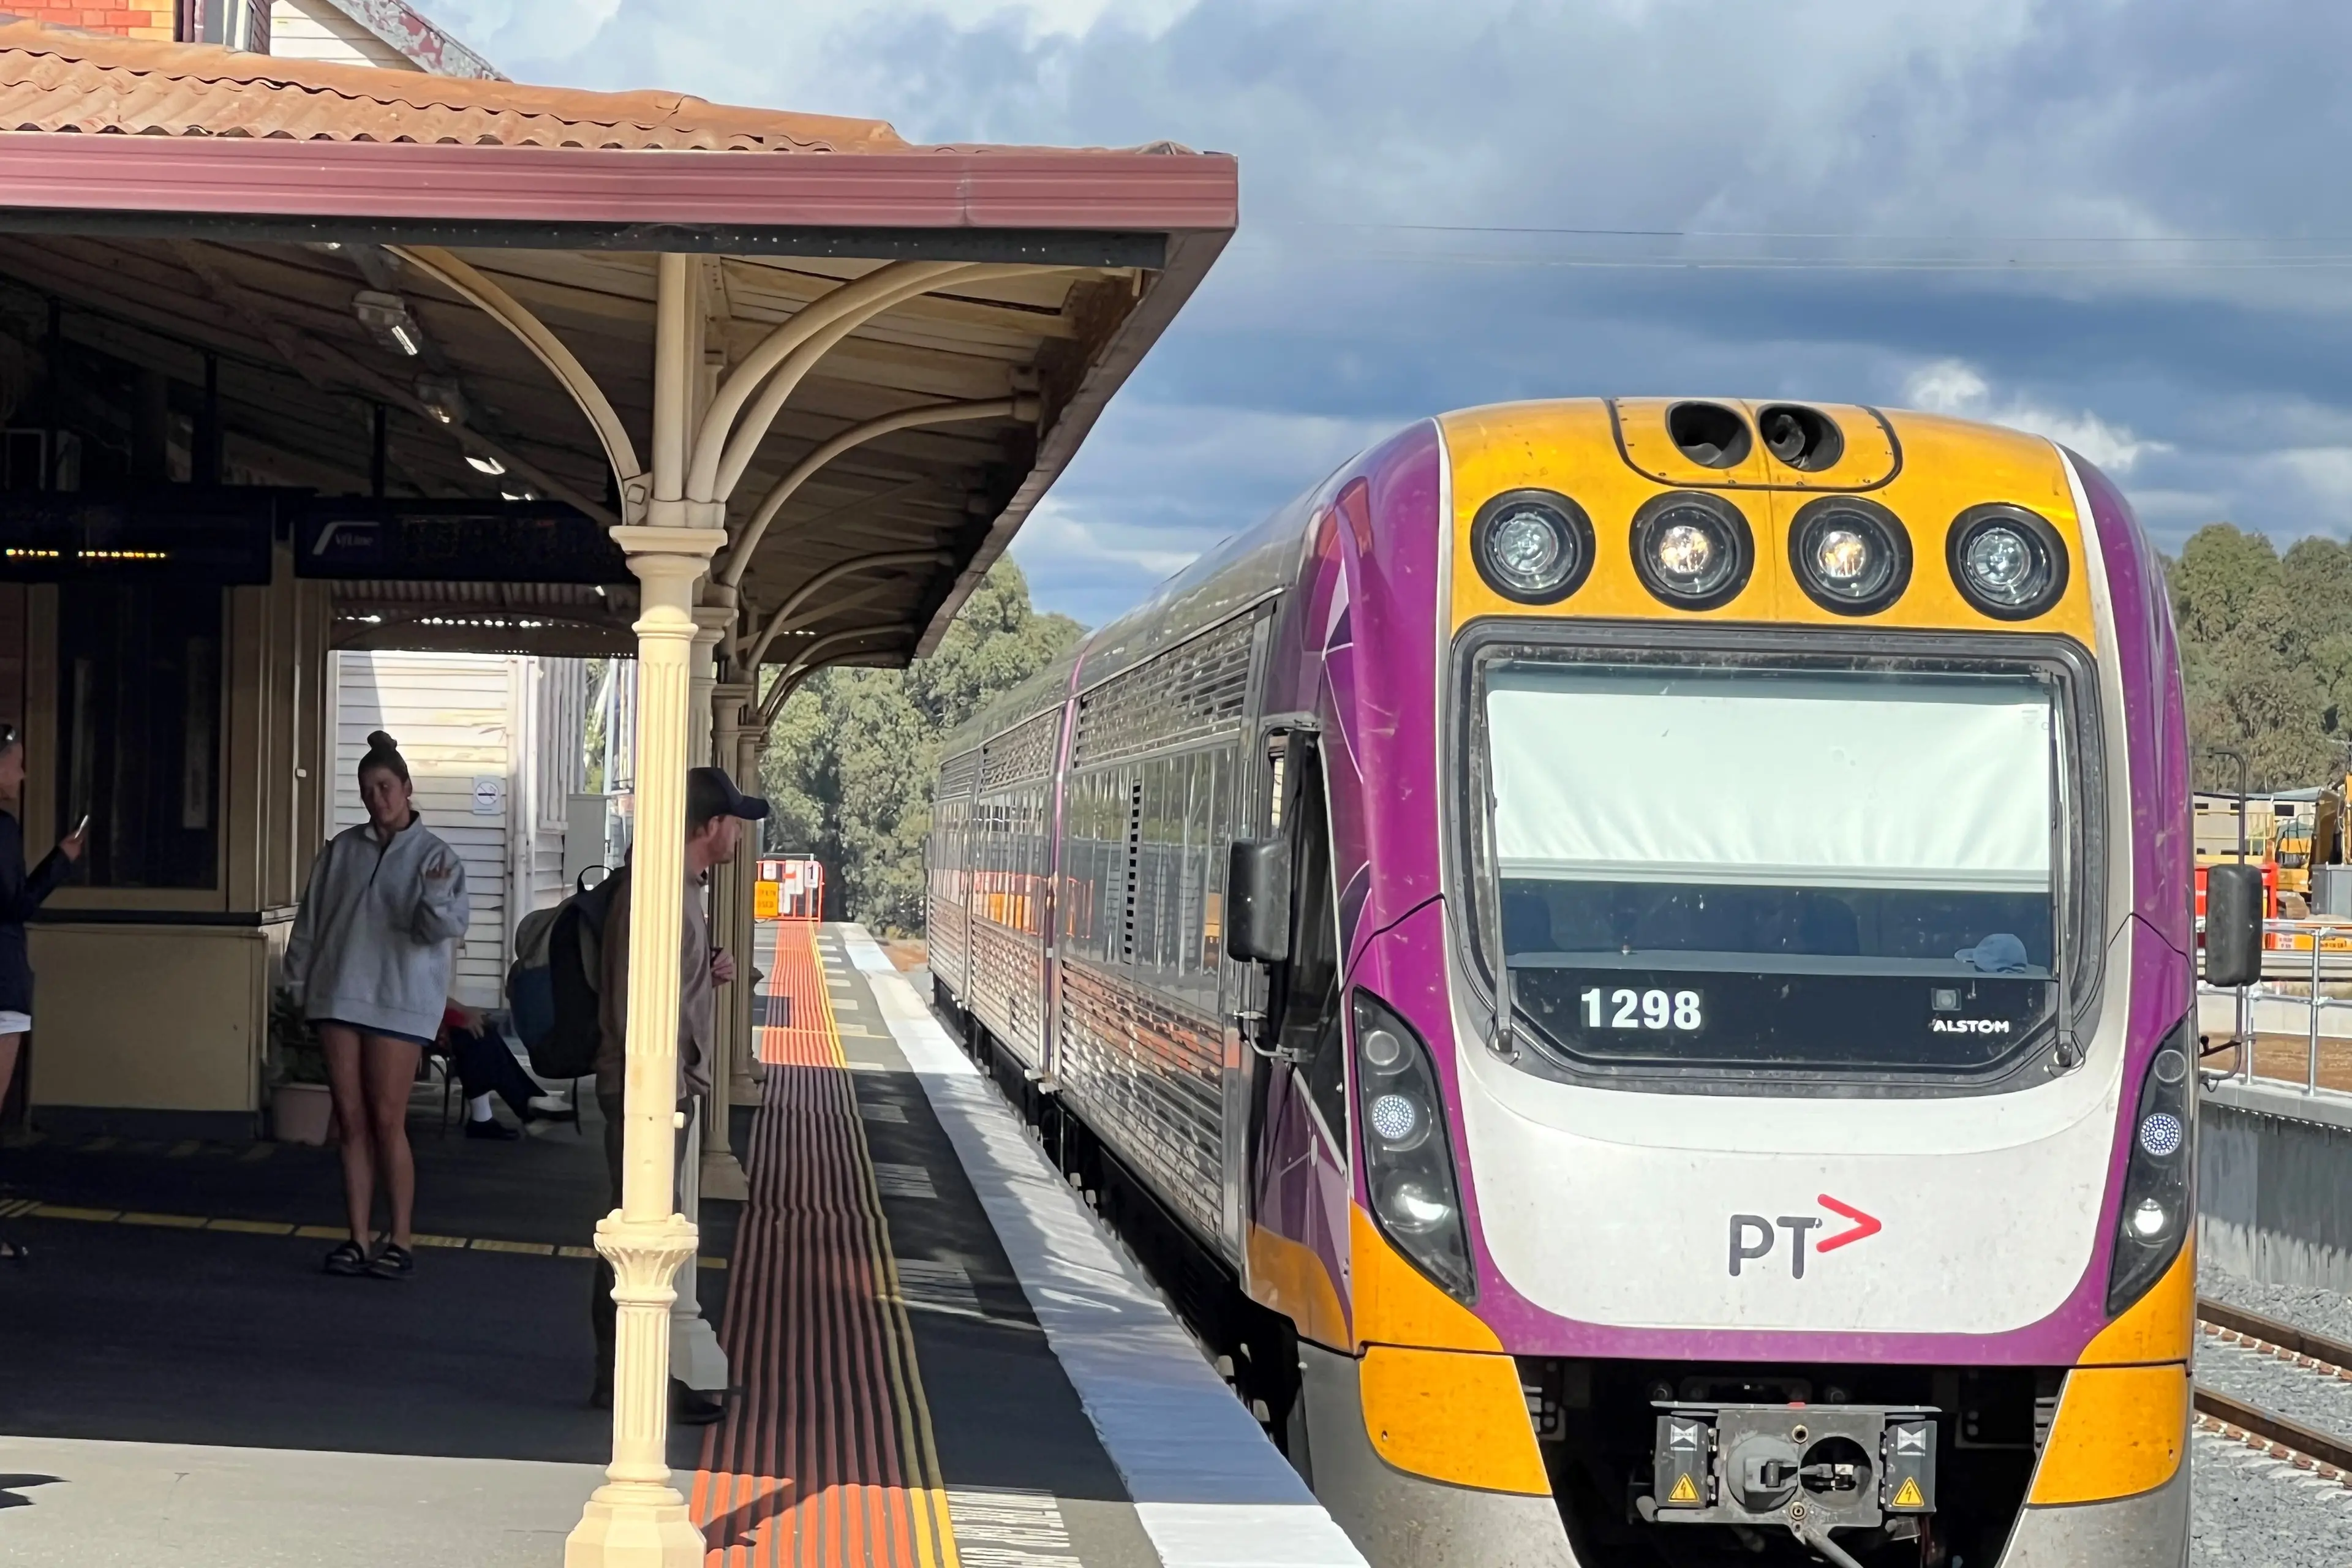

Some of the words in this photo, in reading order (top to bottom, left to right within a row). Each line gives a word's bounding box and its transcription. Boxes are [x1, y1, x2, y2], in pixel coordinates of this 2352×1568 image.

[809, 864, 813, 880] 1
[1581, 989, 1702, 1030] 1298
[1933, 1020, 2010, 1033] ALSTOM
